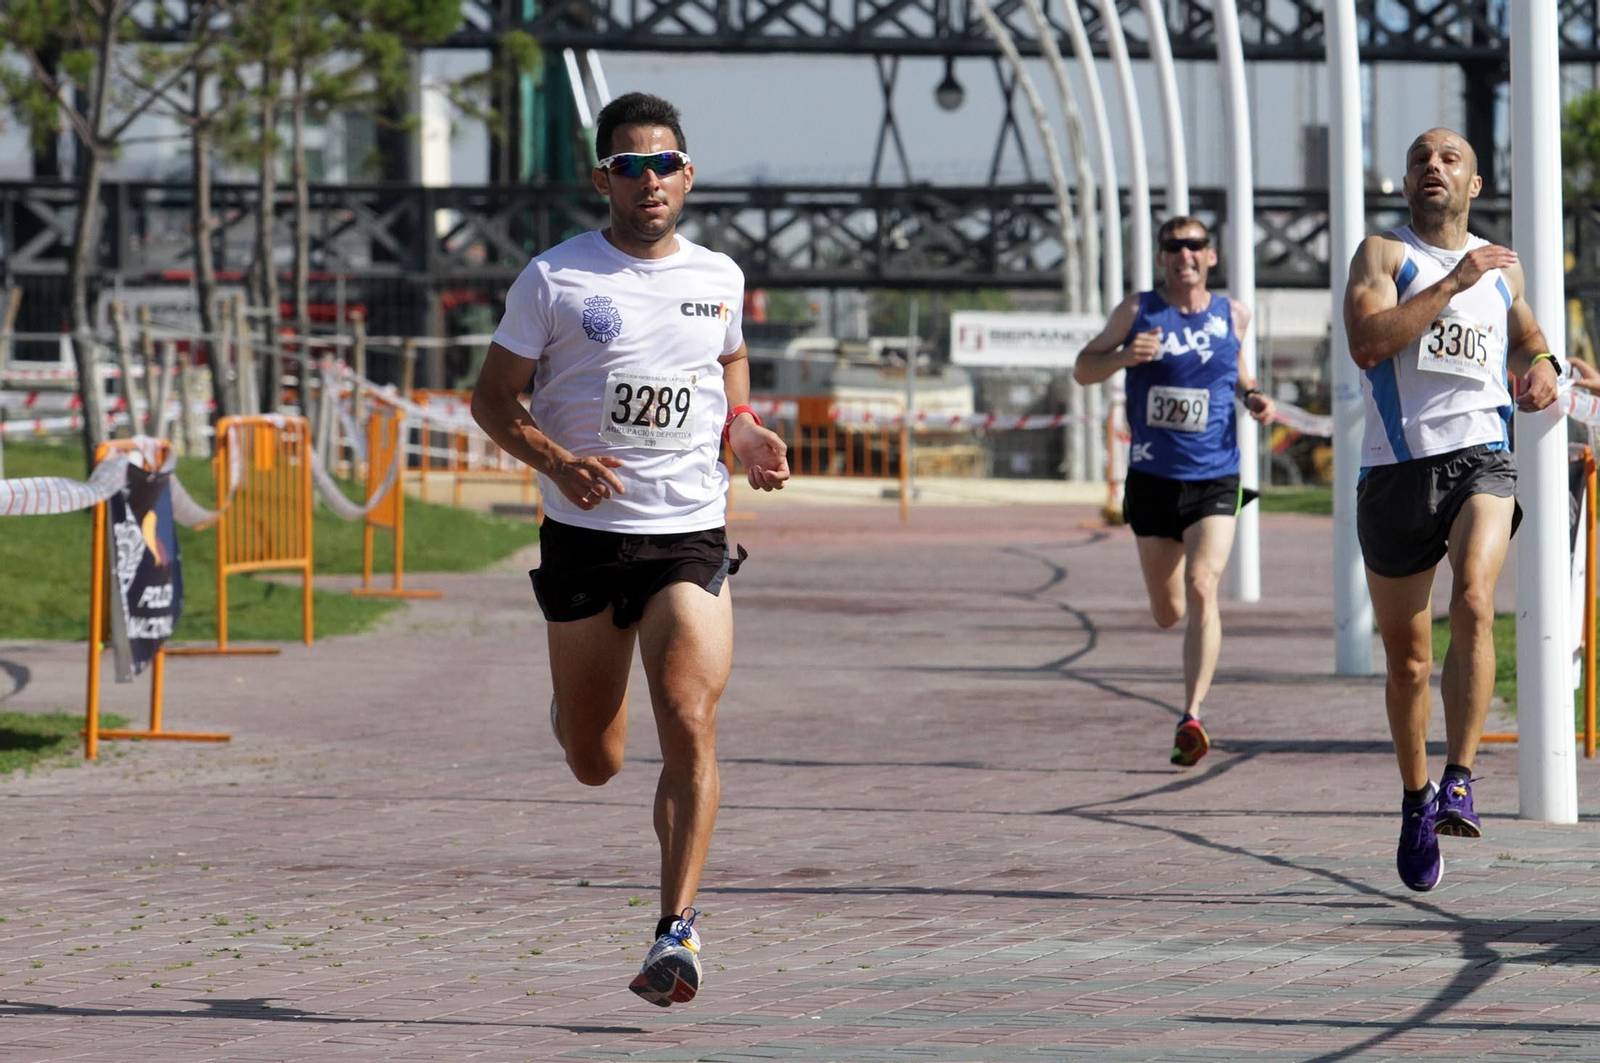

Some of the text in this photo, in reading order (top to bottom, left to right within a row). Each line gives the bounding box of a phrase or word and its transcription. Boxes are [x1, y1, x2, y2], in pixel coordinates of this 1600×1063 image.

[1427, 319, 1487, 364] 3305
[610, 382, 691, 428] 3289
[1152, 396, 1203, 425] 3299
